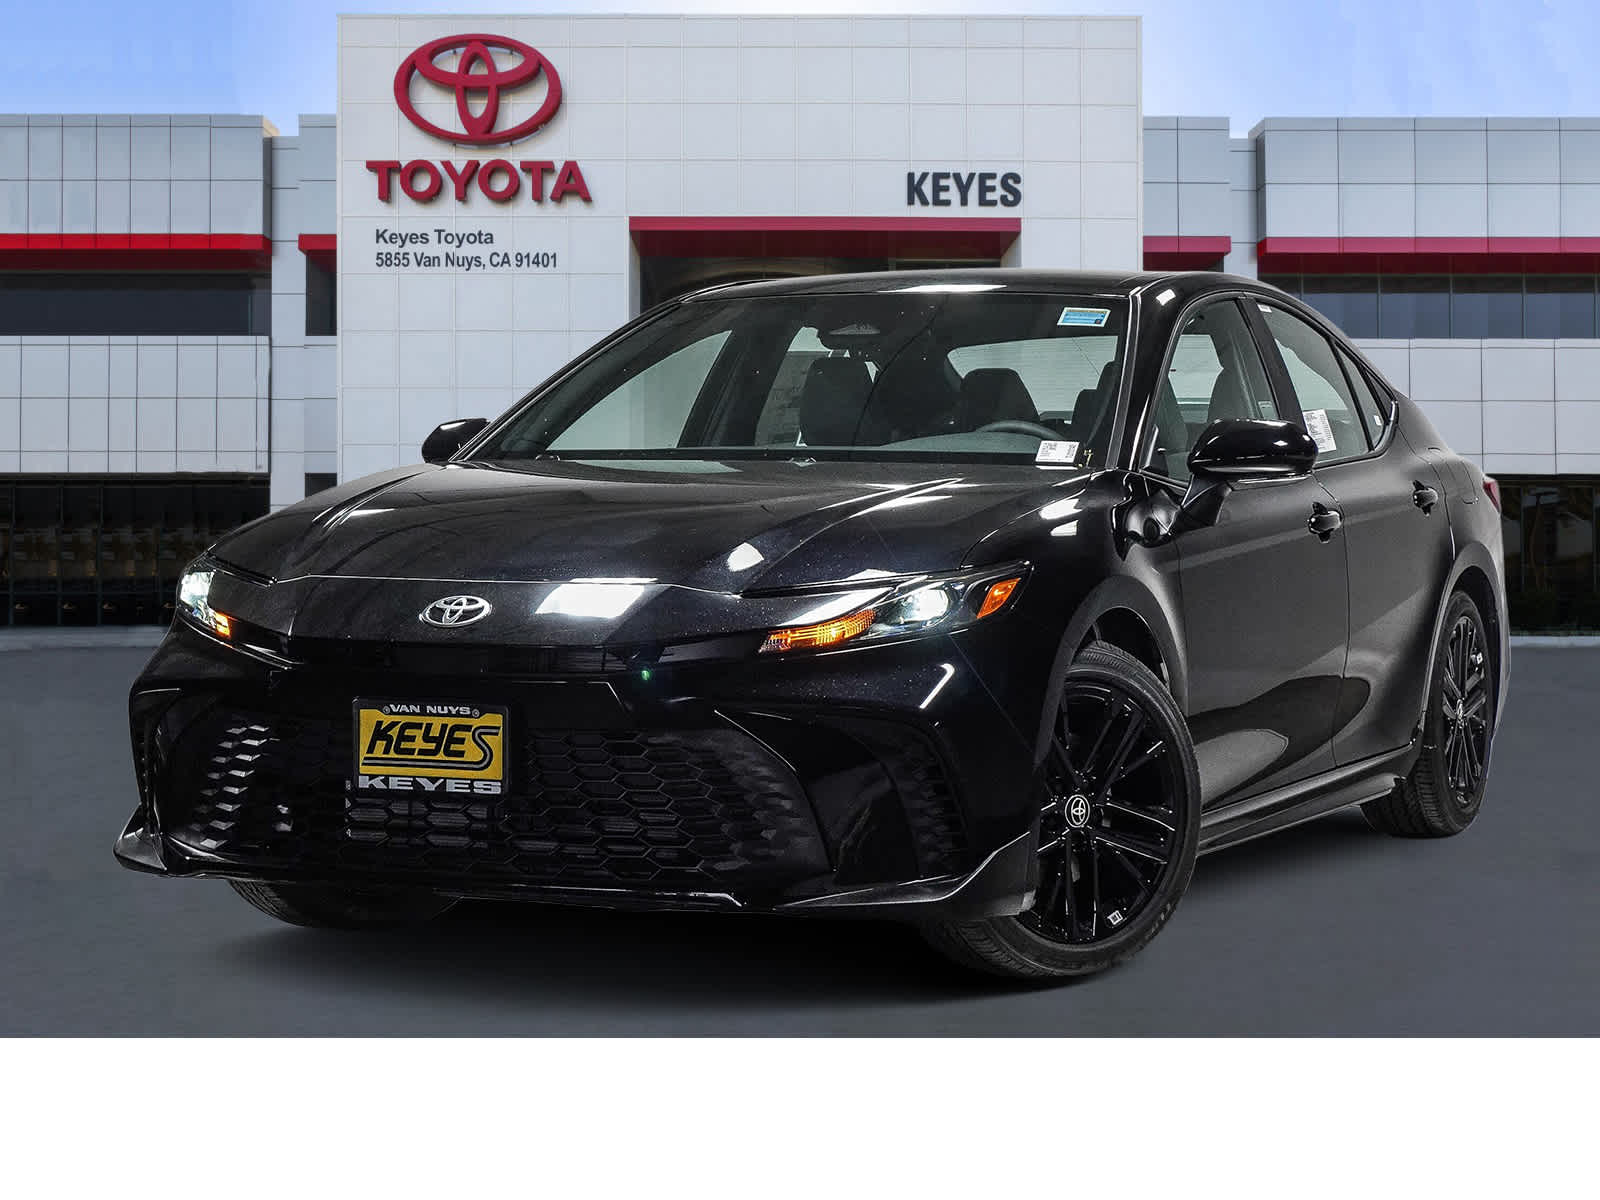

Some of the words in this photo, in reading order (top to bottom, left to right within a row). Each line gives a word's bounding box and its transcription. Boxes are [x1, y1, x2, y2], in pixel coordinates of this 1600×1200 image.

[365, 159, 592, 203] TOYOTA
[906, 172, 1022, 207] KEYES
[375, 229, 430, 248] Keyes
[434, 229, 494, 248] Toyota
[375, 252, 410, 268] 5855
[413, 252, 441, 268] Van
[445, 252, 486, 271] Nuys,
[489, 252, 511, 268] CA
[515, 252, 557, 268] 91401
[389, 704, 420, 713] VAN
[426, 705, 471, 715] NUYS
[362, 720, 501, 771] KEYES
[358, 776, 501, 794] KEYES
